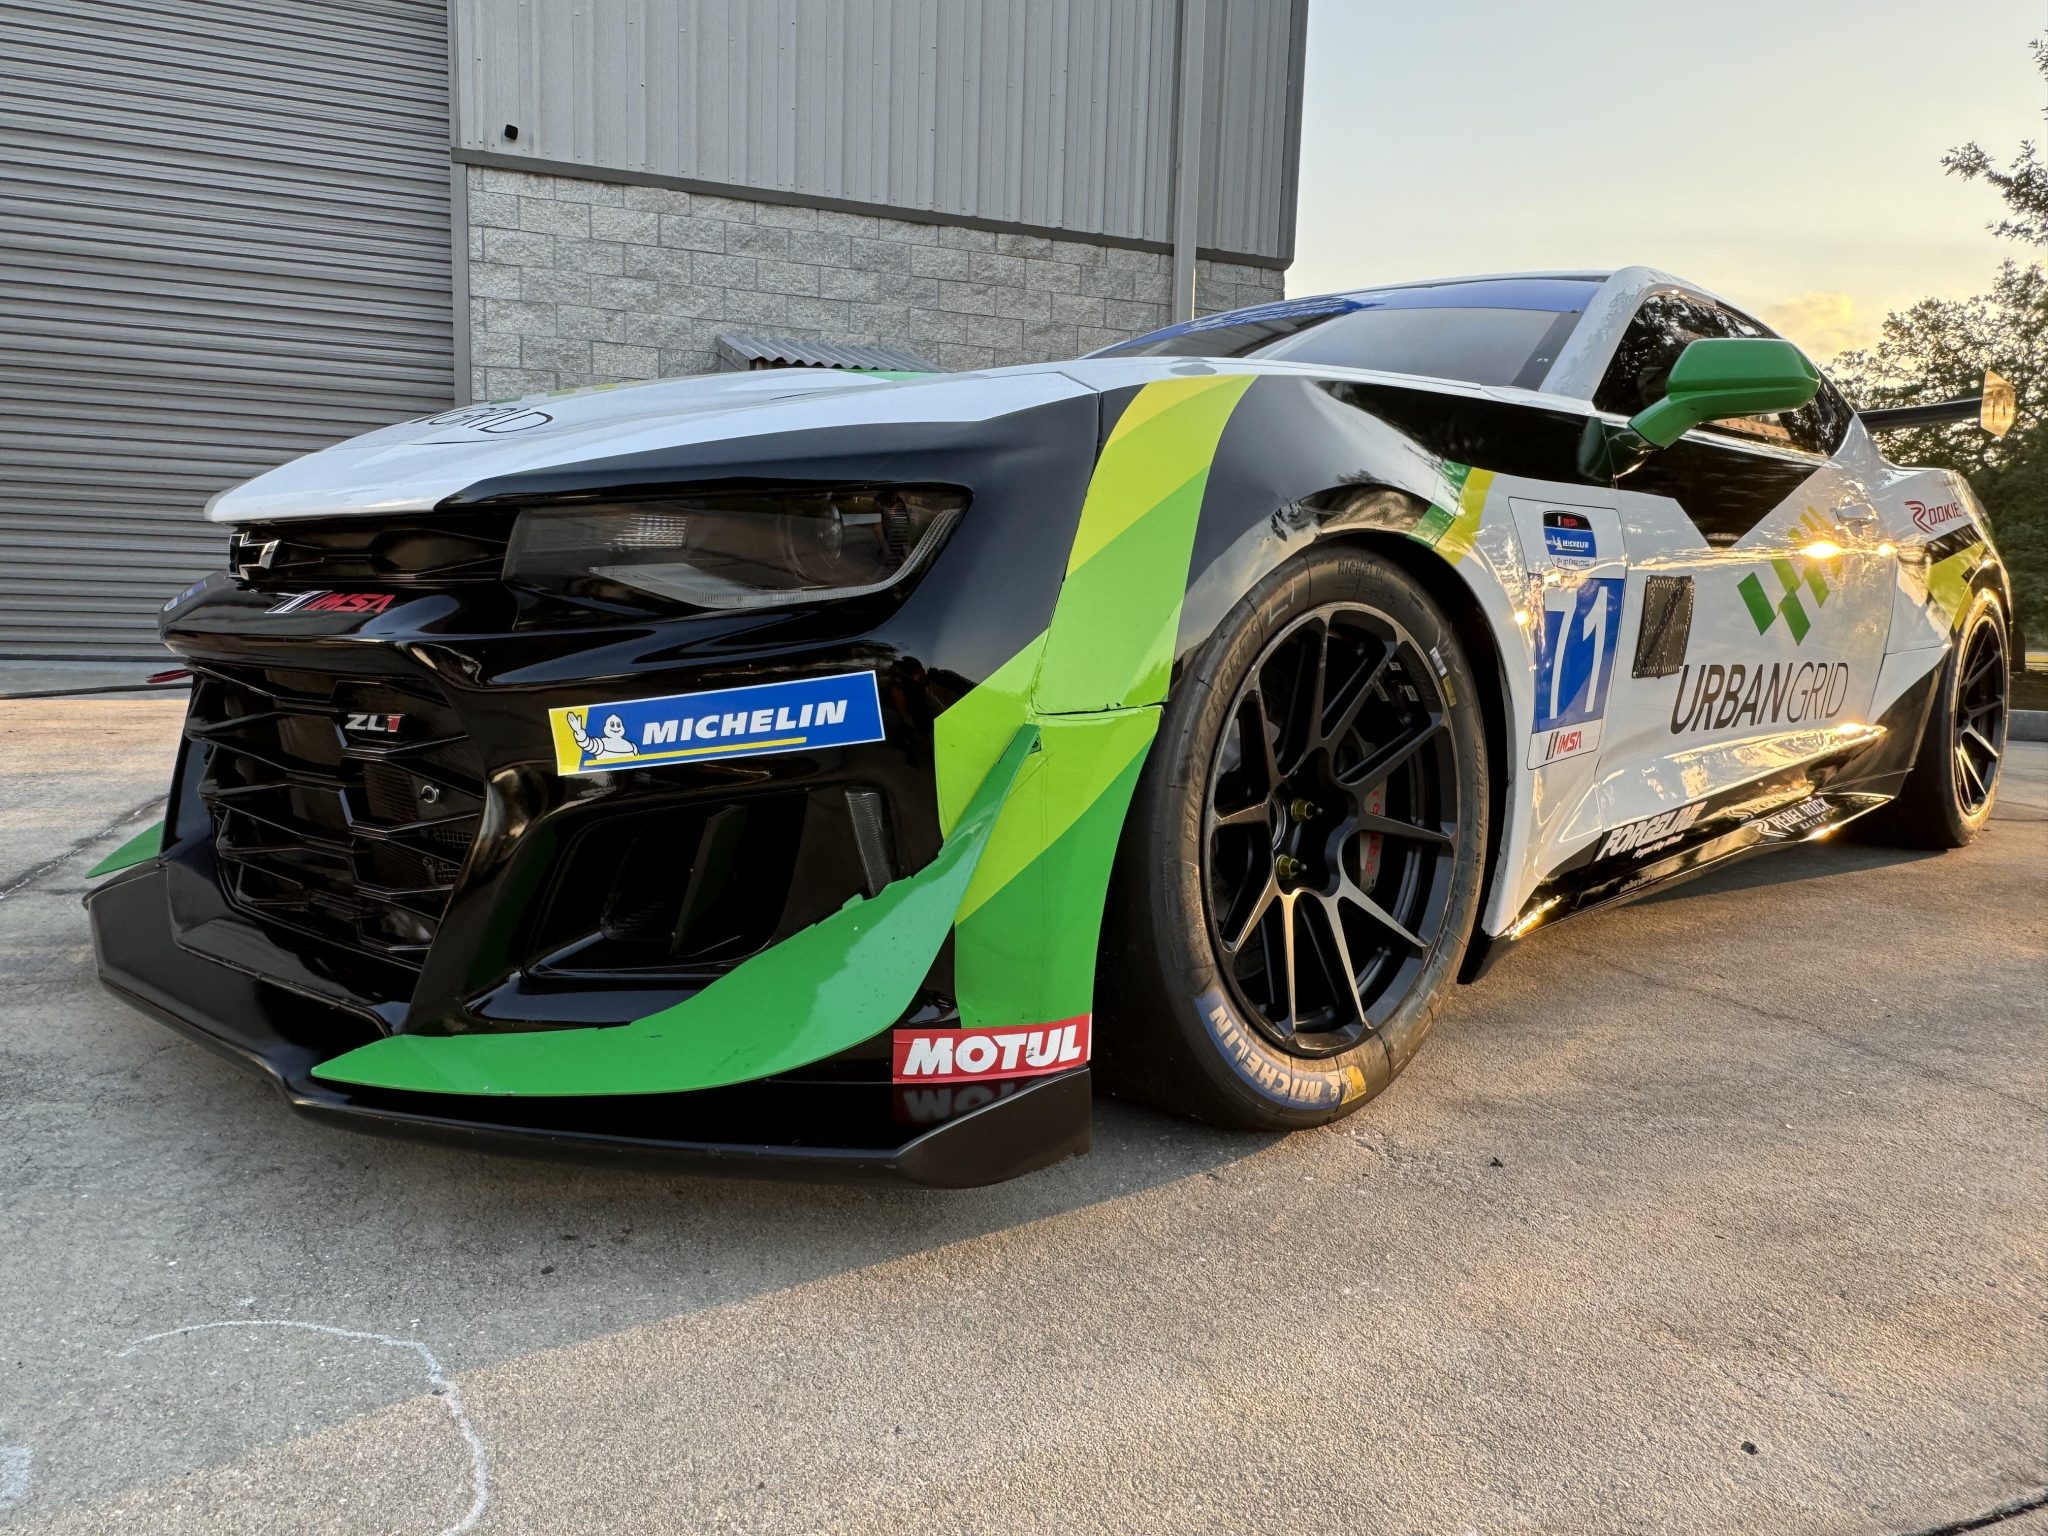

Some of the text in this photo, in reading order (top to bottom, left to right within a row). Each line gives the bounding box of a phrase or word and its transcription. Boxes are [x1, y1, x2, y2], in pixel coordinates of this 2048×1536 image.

[305, 594, 396, 613] IMSA
[1545, 586, 1608, 719] 71
[1670, 662, 1848, 734] URBANGRID
[344, 714, 404, 732] ZL1
[642, 700, 848, 745] MICHELIN
[1557, 731, 1582, 753] IMSA
[1799, 797, 1833, 816] ROCK
[1595, 801, 1707, 861] FORGELINE
[902, 1024, 1081, 1075] MOTUL
[1209, 1005, 1322, 1102] MICHELIN
